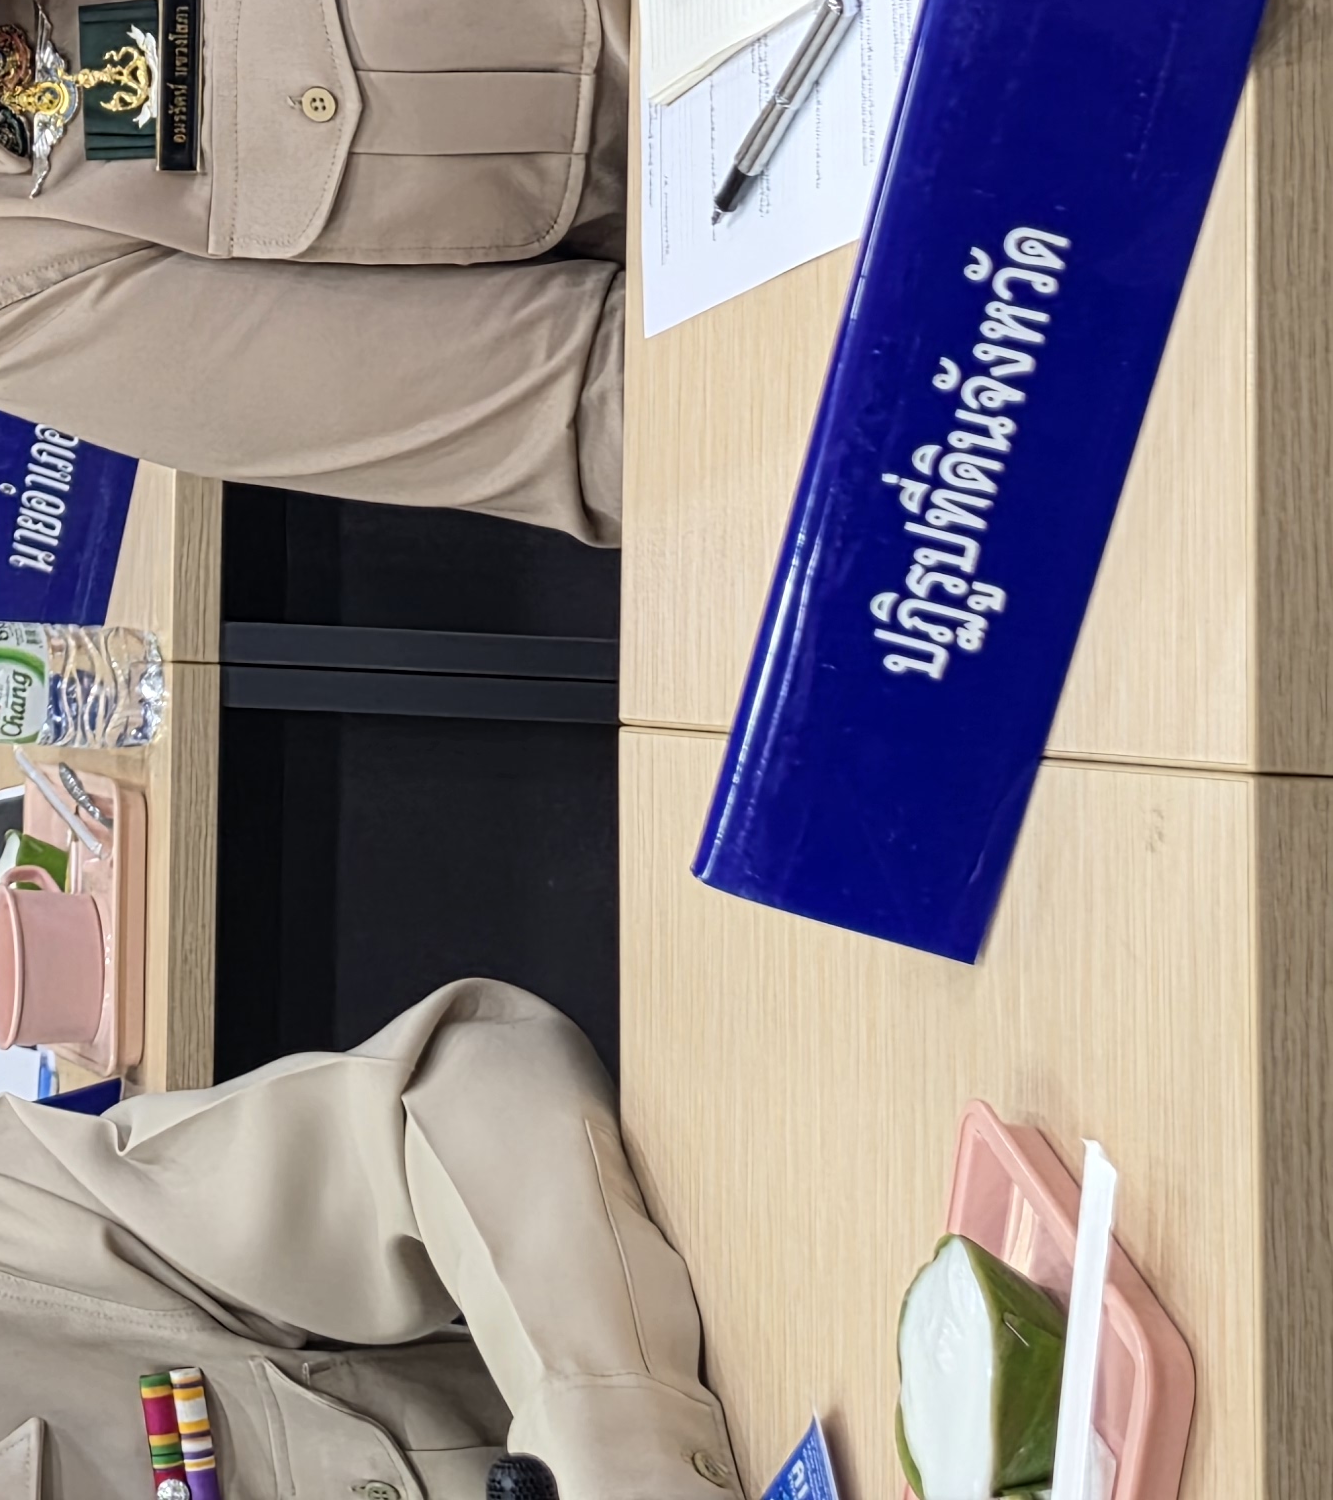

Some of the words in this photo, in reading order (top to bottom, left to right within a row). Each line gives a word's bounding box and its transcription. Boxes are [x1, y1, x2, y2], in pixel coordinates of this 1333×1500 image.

[869, 226, 1071, 680] ปฏิรูปที่ดินจังหวัด
[0, 669, 33, 737] Chang
